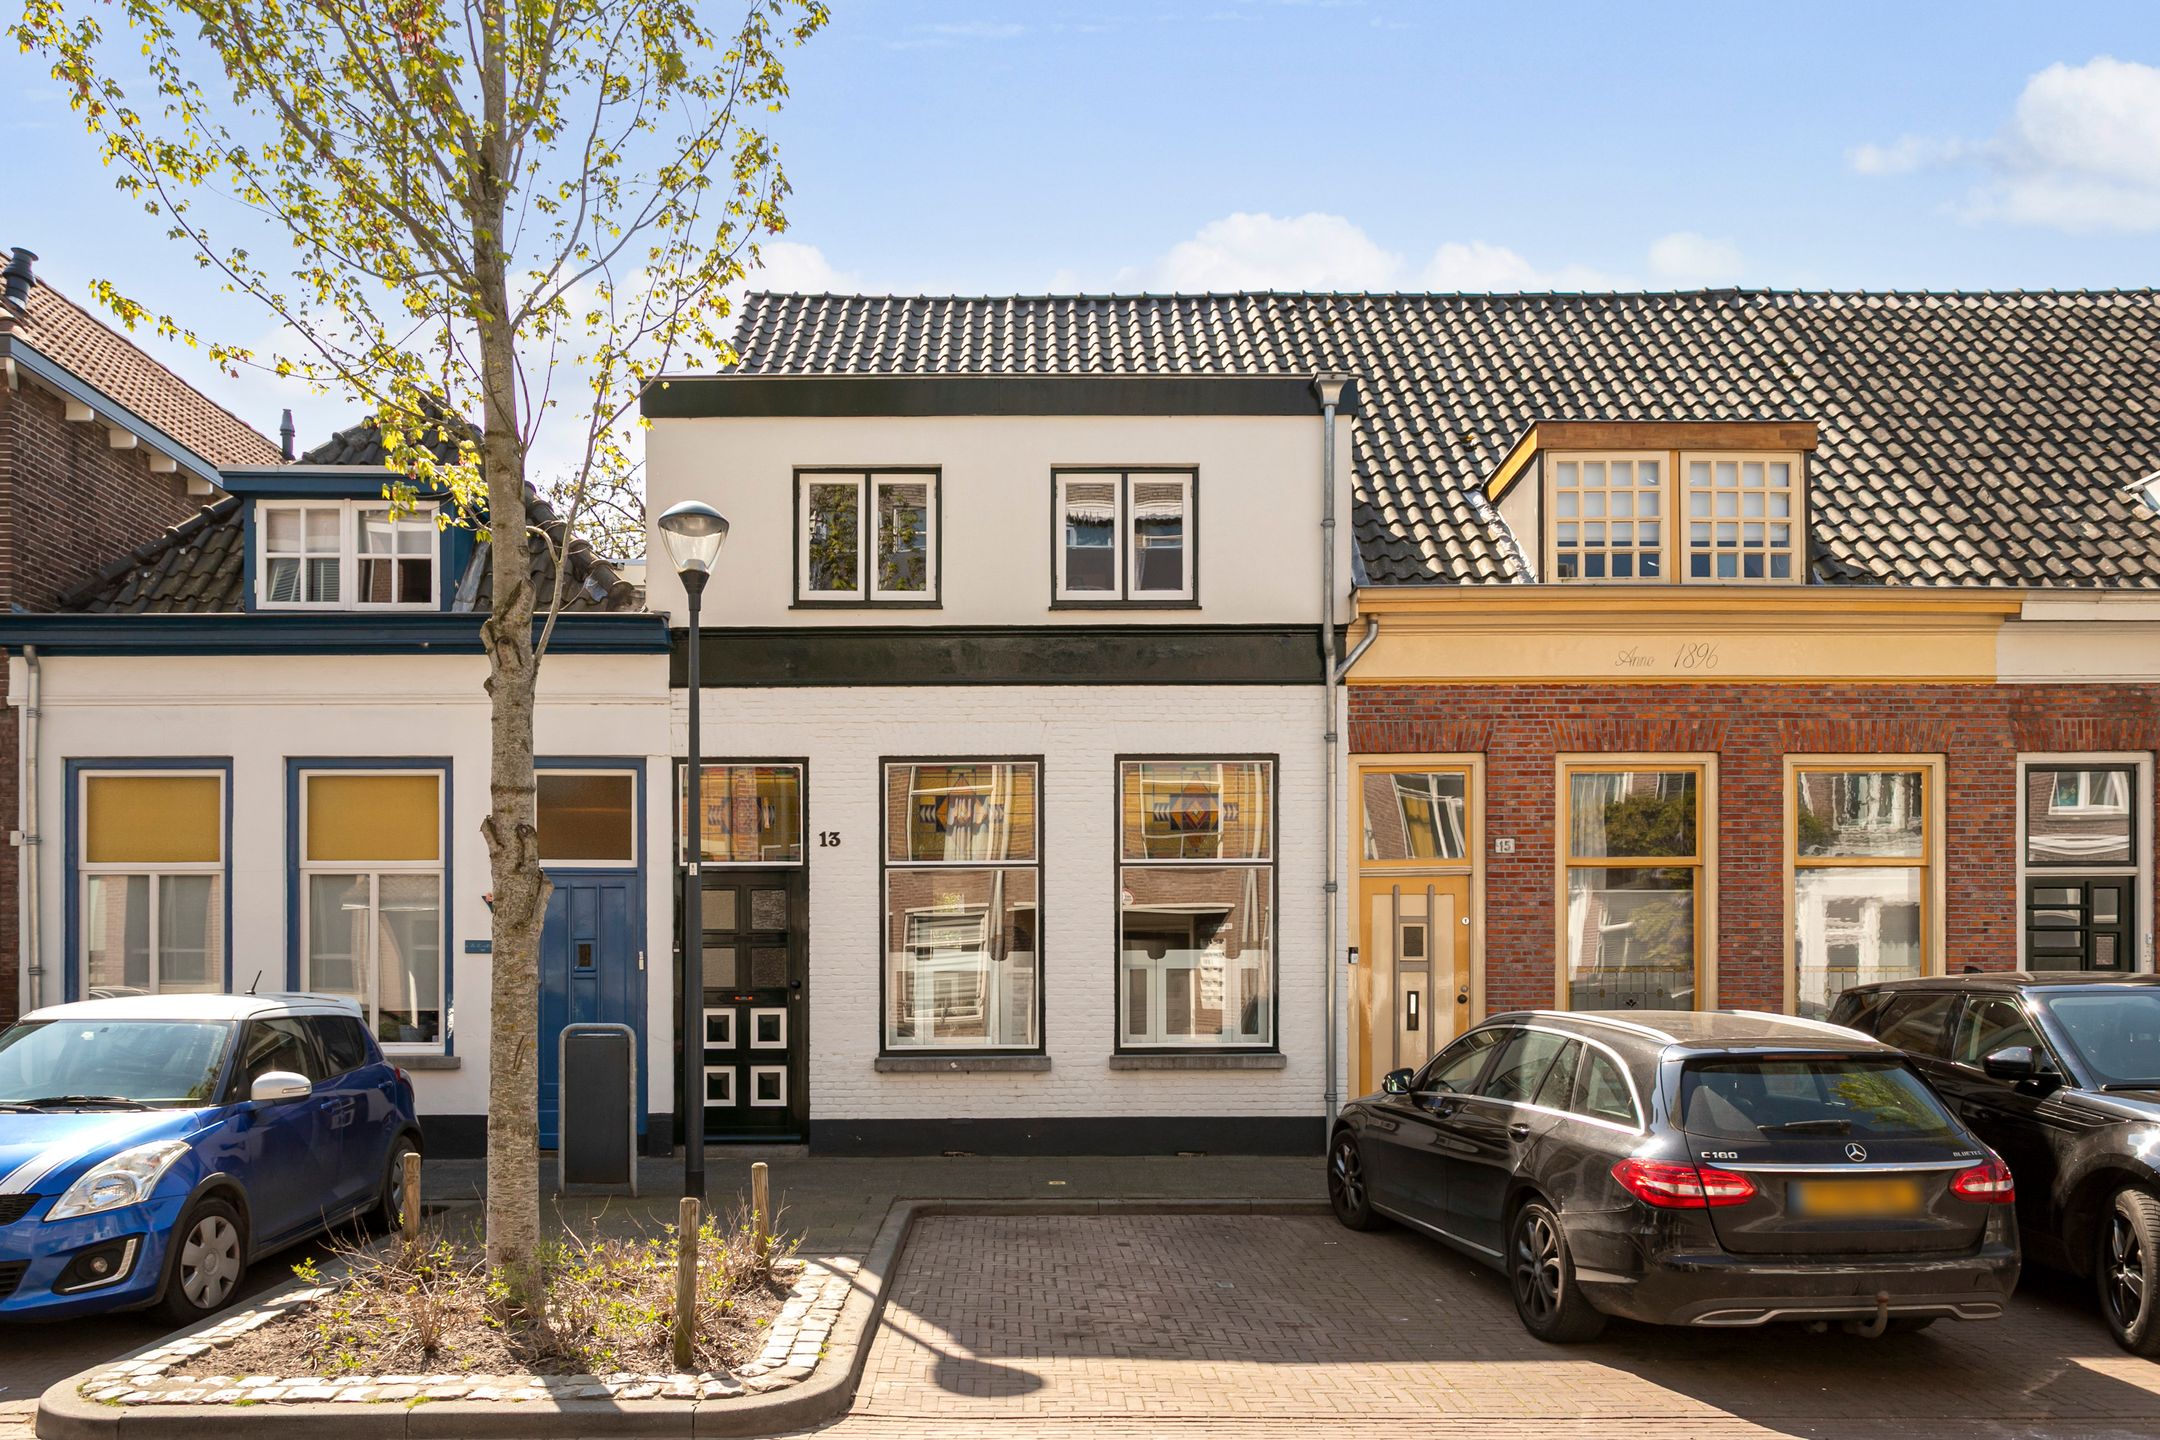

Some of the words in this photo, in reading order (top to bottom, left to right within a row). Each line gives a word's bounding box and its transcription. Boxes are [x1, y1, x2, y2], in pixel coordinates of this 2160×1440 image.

[1615, 646, 1655, 667] Anno
[1674, 643, 1720, 669] 1896
[819, 831, 841, 847] 13
[1500, 840, 1511, 851] 15
